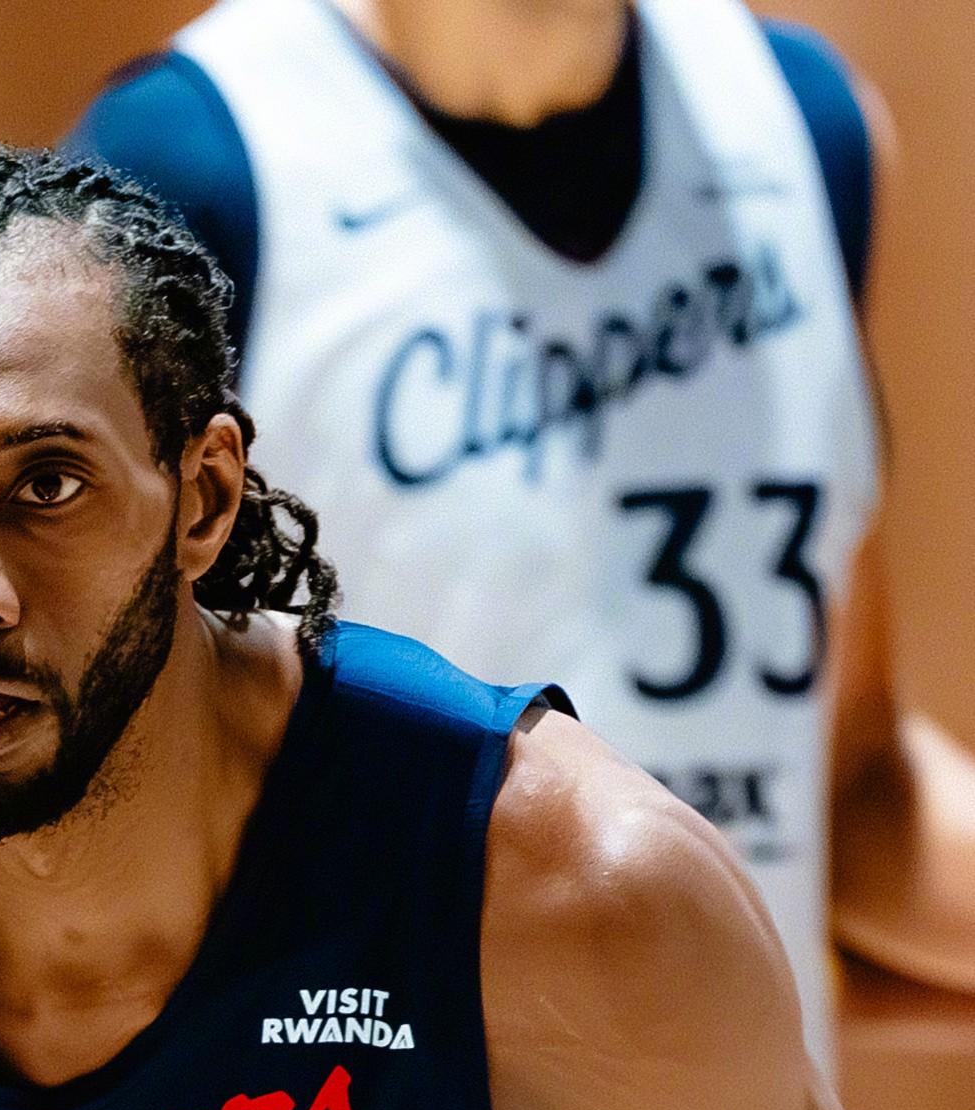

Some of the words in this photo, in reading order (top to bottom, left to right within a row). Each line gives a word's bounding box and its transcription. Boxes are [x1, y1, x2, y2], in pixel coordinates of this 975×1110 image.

[616, 482, 828, 702] 33
[299, 988, 390, 1017] VISIT
[261, 1017, 415, 1050] RWANDA
